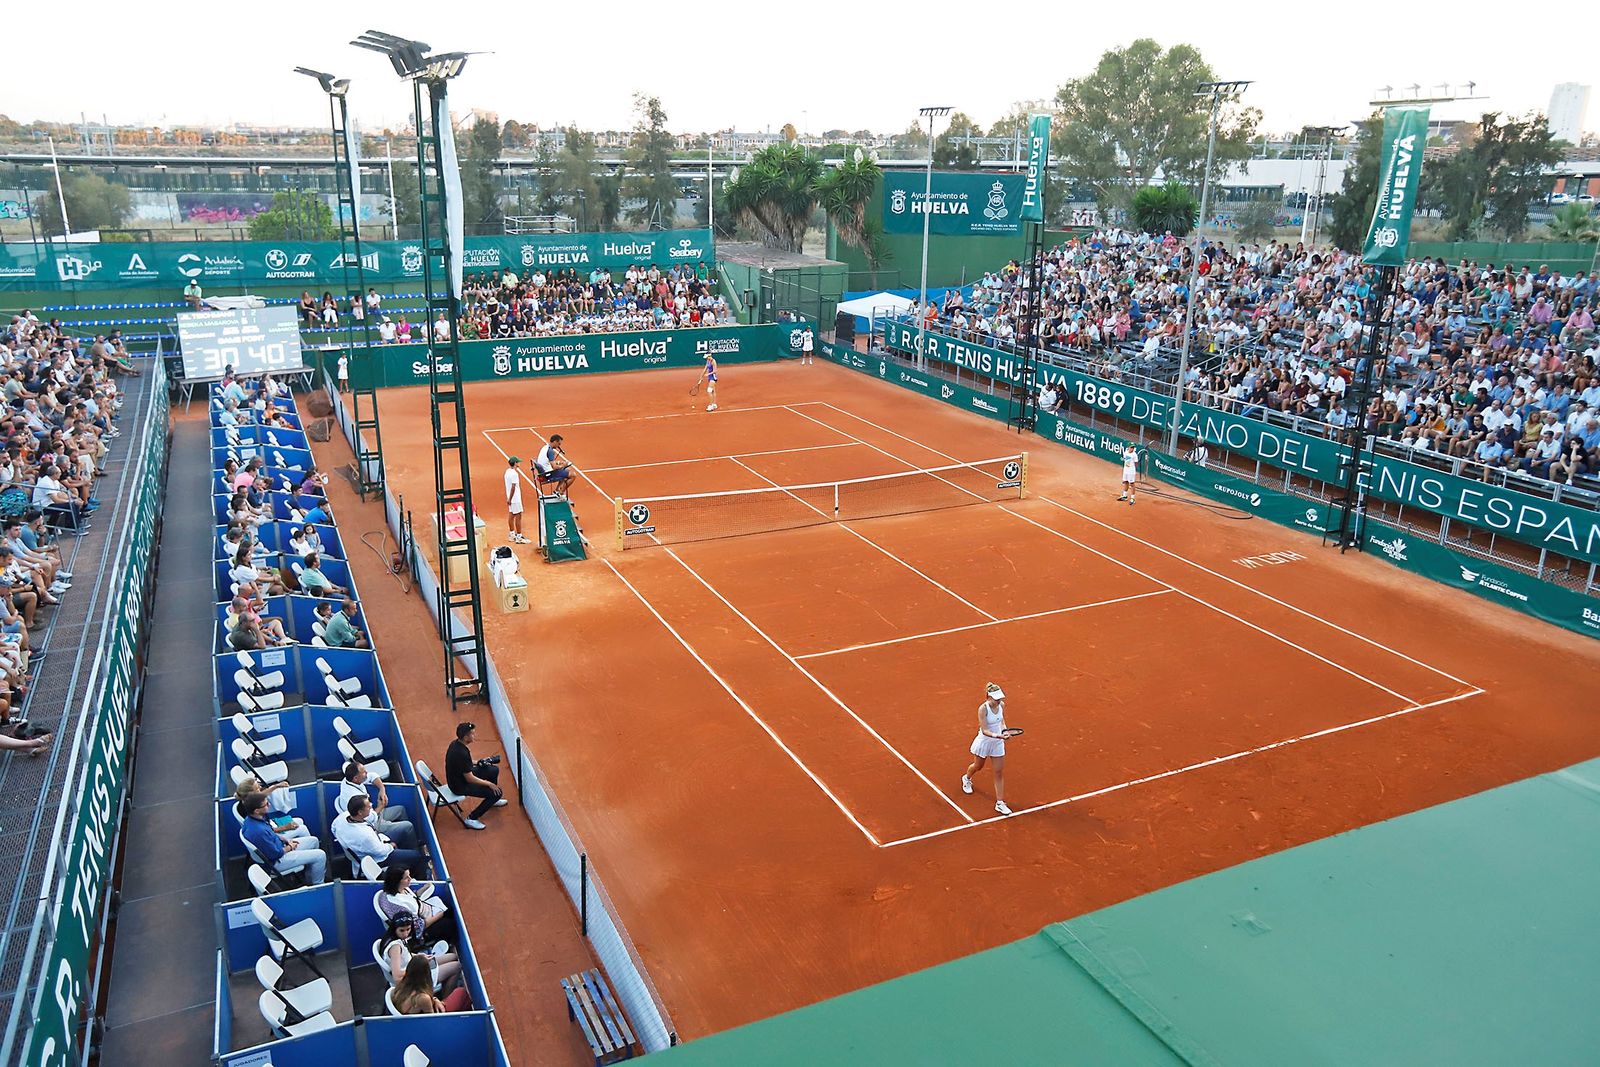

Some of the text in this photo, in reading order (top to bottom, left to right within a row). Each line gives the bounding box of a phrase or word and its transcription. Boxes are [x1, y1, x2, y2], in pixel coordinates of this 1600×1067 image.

[1023, 137, 1041, 206] Huelva
[1389, 135, 1416, 219] HUELVA
[911, 202, 969, 214] HUELVA
[464, 248, 499, 260] PUTACIÓN
[538, 244, 578, 252] Ayuntamiento
[604, 242, 651, 255] Huelva
[669, 247, 702, 258] Seabery
[538, 253, 589, 264] HUELVA
[248, 343, 285, 364] 40
[516, 343, 586, 355] Ayuntamiento de
[600, 337, 666, 358] Huelva
[200, 347, 239, 370] 30
[517, 354, 589, 372] HUELVA
[643, 355, 666, 364] original
[946, 342, 992, 373] TENIS
[1075, 380, 1125, 413] 1889
[1131, 396, 1248, 448] DECANO
[1258, 431, 1318, 473] DEL
[1335, 452, 1444, 508] TENIS
[1065, 431, 1095, 451] HUELVA
[1101, 436, 1130, 454] Huelv
[72, 763, 111, 949] TENIS
